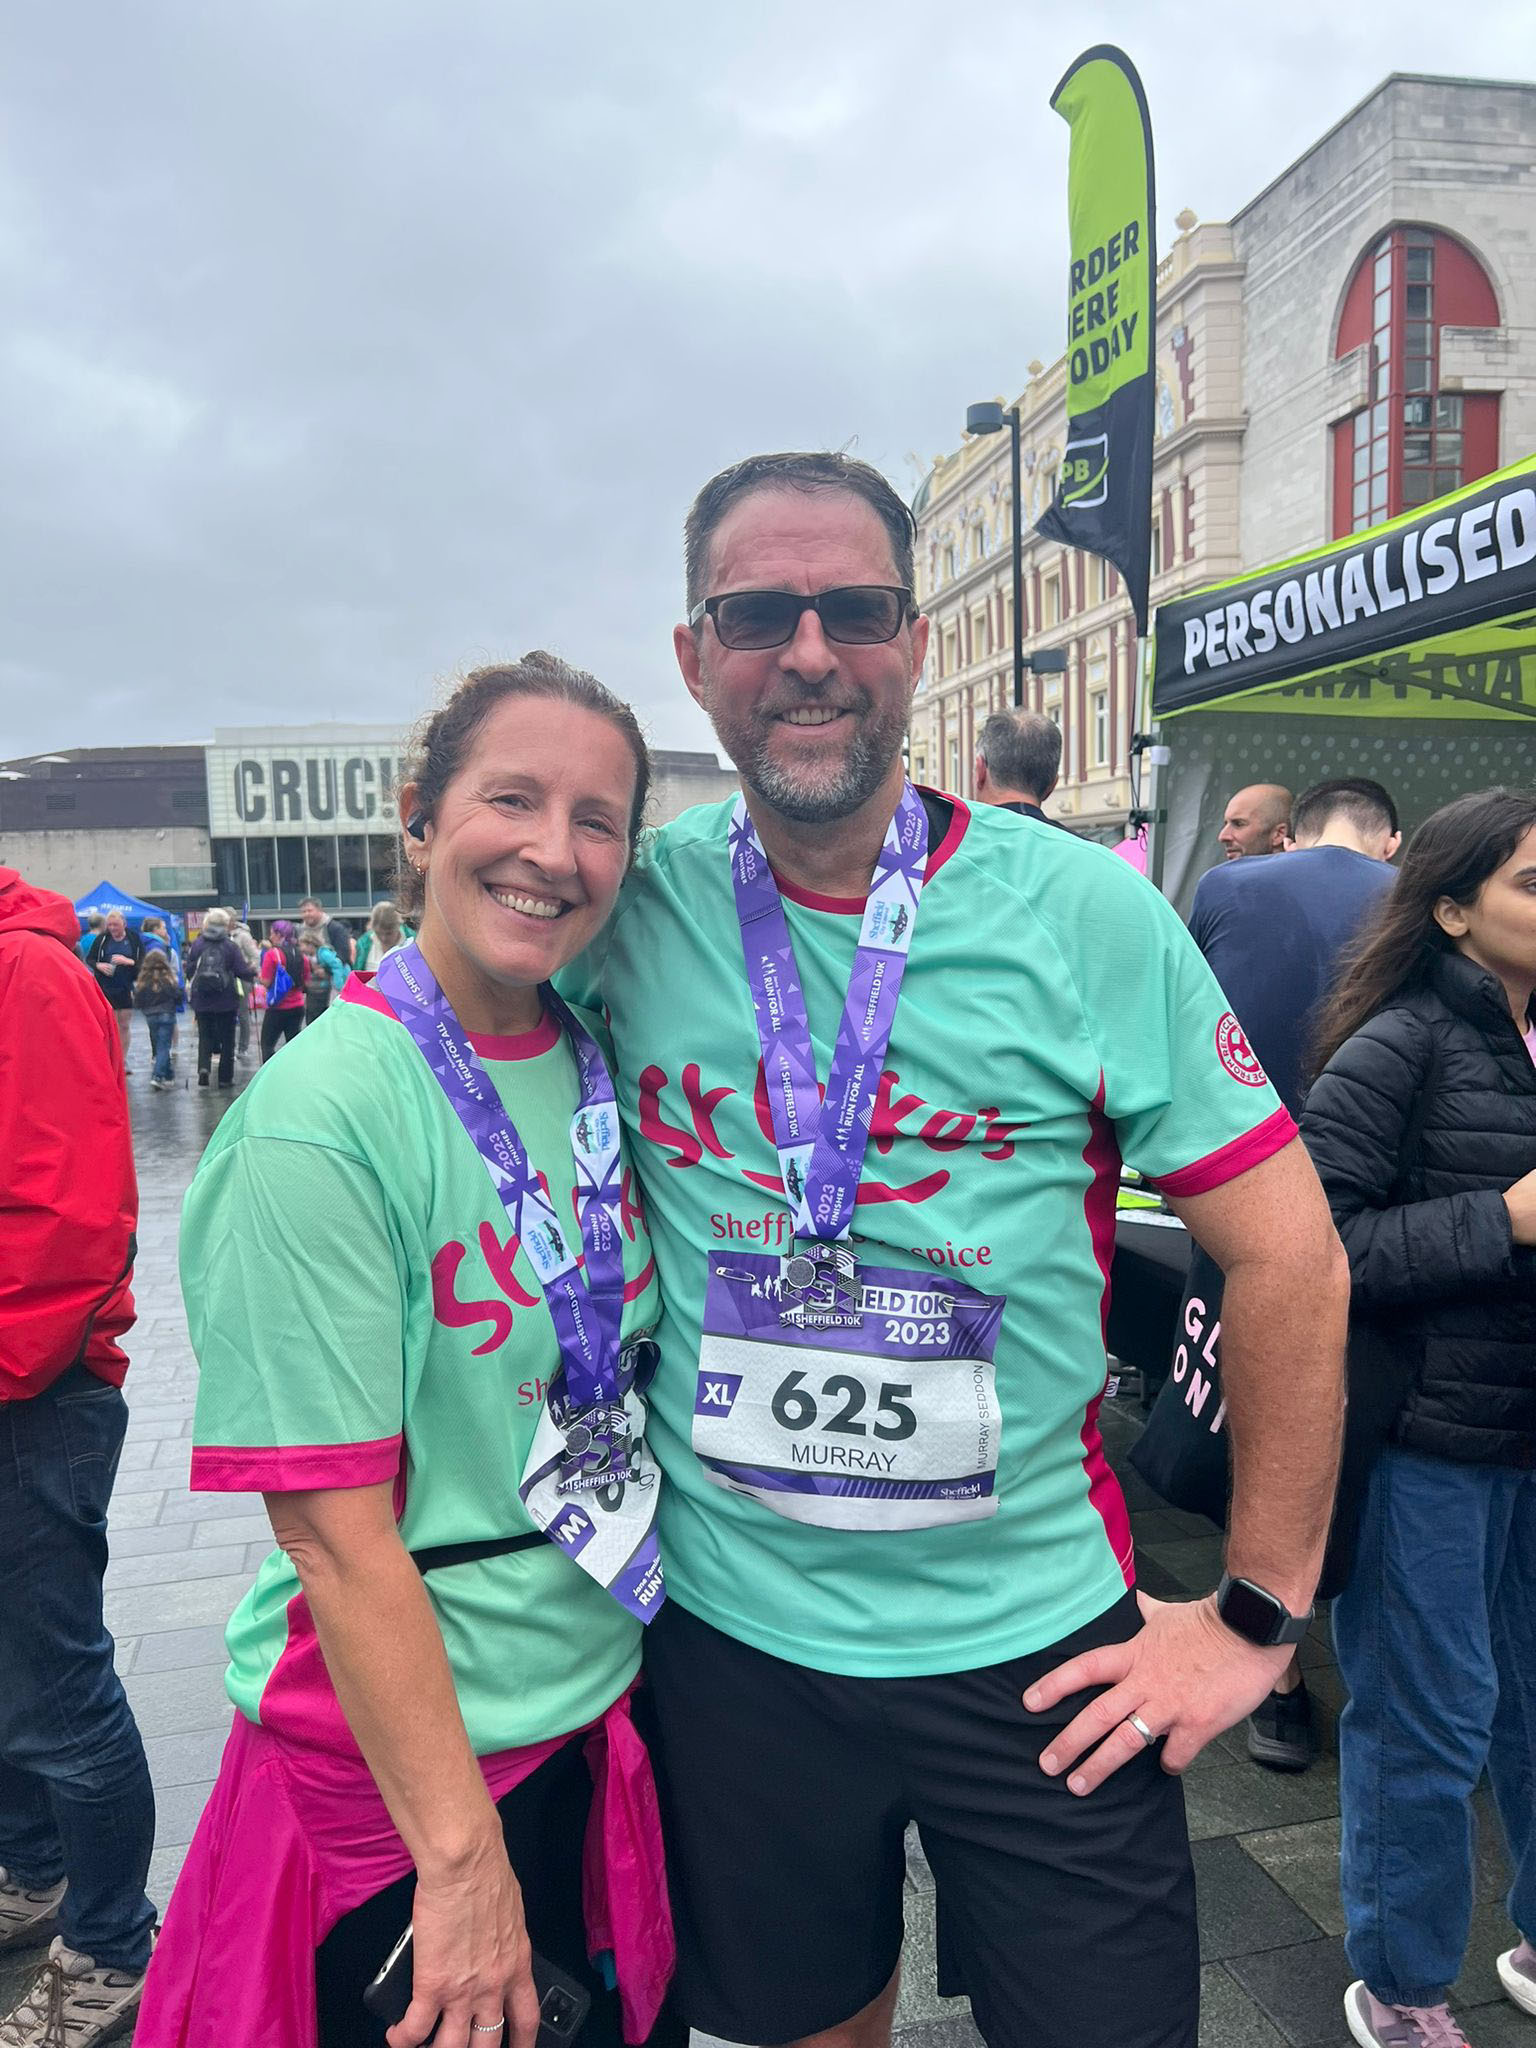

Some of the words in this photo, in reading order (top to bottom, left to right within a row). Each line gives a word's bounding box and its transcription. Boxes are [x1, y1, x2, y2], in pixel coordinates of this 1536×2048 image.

[1071, 220, 1139, 298] RDER
[1069, 279, 1119, 344] ERE
[1070, 311, 1138, 385] ODAY
[1183, 487, 1536, 675] PERSONALISED
[234, 757, 395, 822] CRUCI
[902, 811, 917, 847] 2023
[912, 818, 922, 850] FINISHER
[738, 853, 747, 885] FINISHER
[744, 847, 757, 880] 2023
[869, 900, 885, 939] Sheffield
[397, 962, 421, 993] SHEFFIELD
[764, 977, 774, 997] RUN
[864, 978, 881, 1026] SHEFFIELD
[876, 961, 886, 978] 10K
[768, 997, 779, 1017] FOR
[437, 1022, 450, 1038] ALL
[772, 1016, 782, 1032] ALL
[1220, 1018, 1234, 1057] RECYCL
[446, 1039, 461, 1058] FOR
[456, 1057, 473, 1079] RUN
[854, 1063, 865, 1081] ALL
[781, 1071, 796, 1118] SHEFFIELD
[789, 1118, 799, 1137] 10K
[849, 1082, 860, 1104] FOR
[599, 1111, 610, 1151] Sheffield
[844, 1104, 856, 1126] RUN
[489, 1132, 515, 1170] 2023
[500, 1129, 522, 1165] FINISHER
[816, 1184, 835, 1224] 2023
[830, 1186, 845, 1226] FINISHER
[590, 1213, 600, 1252] FINISHER
[598, 1212, 611, 1251] 2023
[528, 1230, 550, 1270] Sheffield
[564, 1282, 576, 1299] 10K
[858, 1289, 906, 1315] IELD
[911, 1294, 949, 1316] 10K
[570, 1298, 588, 1348] SHEFFIELD
[795, 1315, 842, 1326] SHEFFIELD
[843, 1315, 861, 1326] 10K
[885, 1319, 951, 1345] 2023
[594, 1384, 603, 1400] ALL
[702, 1382, 732, 1407] XL
[771, 1370, 917, 1441] 625
[974, 1365, 989, 1419] SEDDON
[792, 1443, 898, 1473] MURRAY
[977, 1423, 990, 1469] MURRAY
[573, 1473, 616, 1490] SHEFFIELD
[617, 1470, 632, 1481] 10K
[940, 1483, 981, 1497] Sheffield
[560, 1512, 588, 1544] M
[632, 1577, 648, 1596] Jane
[638, 1574, 662, 1606] RUN
